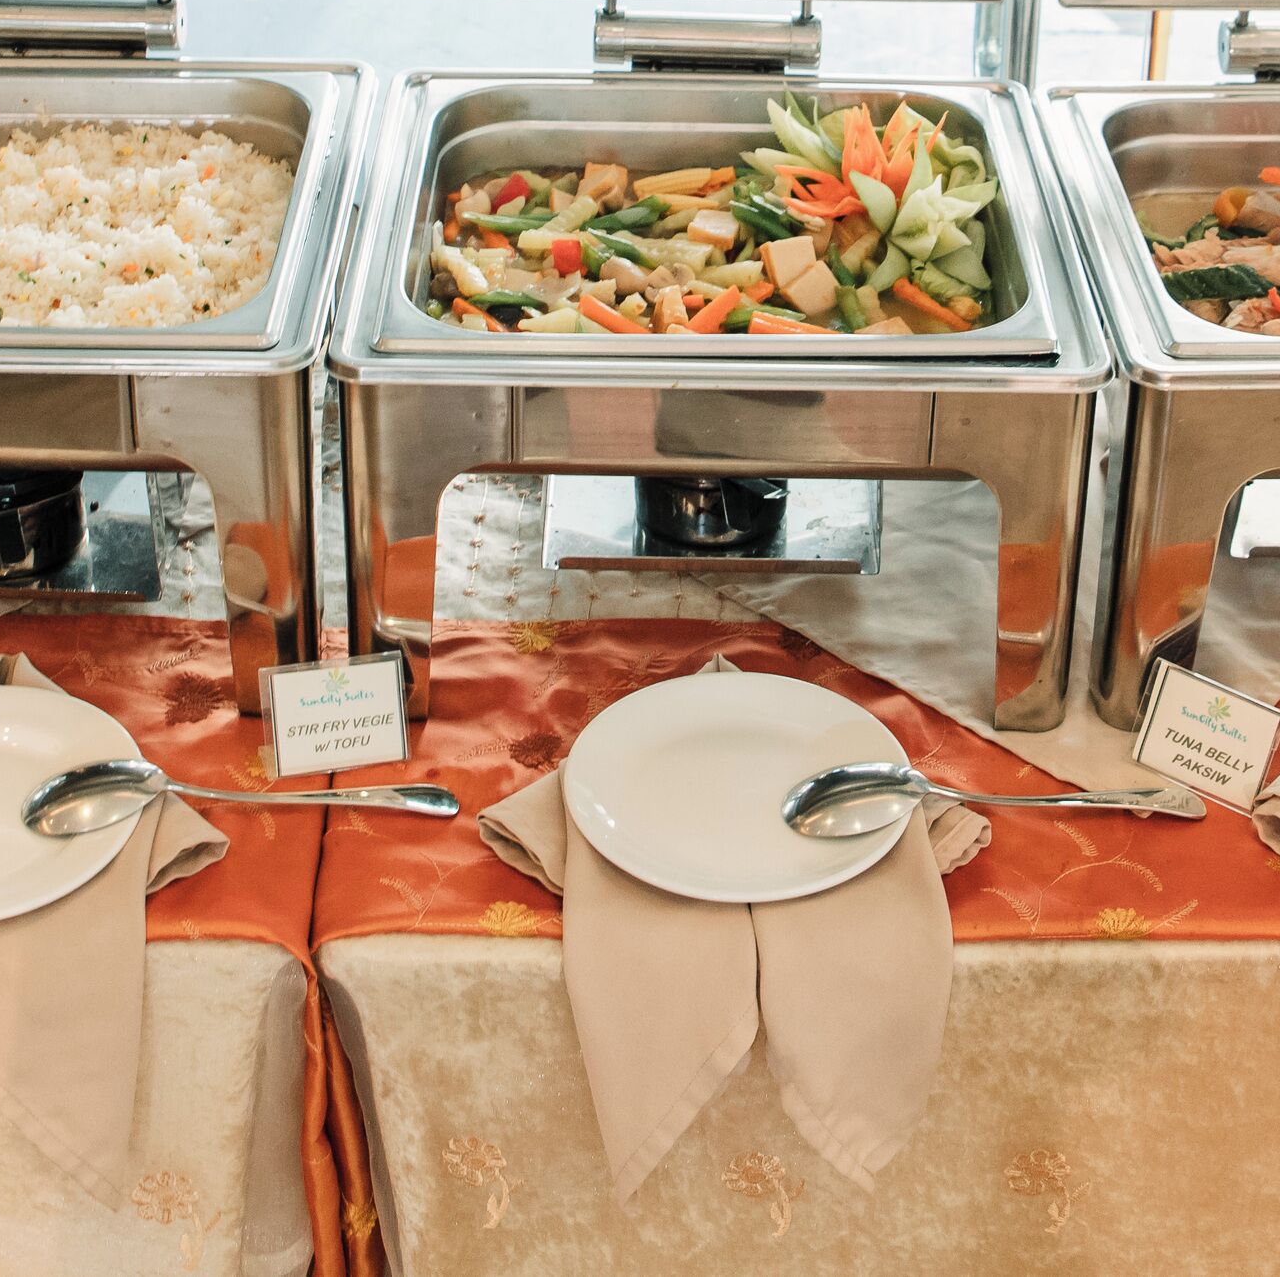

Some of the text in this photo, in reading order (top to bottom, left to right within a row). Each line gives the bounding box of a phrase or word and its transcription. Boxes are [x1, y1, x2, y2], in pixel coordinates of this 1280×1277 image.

[287, 713, 395, 738] STIR FRY VEGIE
[1219, 723, 1248, 743] Suites
[315, 735, 371, 753] w/ TOFU
[1164, 727, 1255, 774] TUNA BELLY
[1172, 753, 1232, 786] PAKSIW
